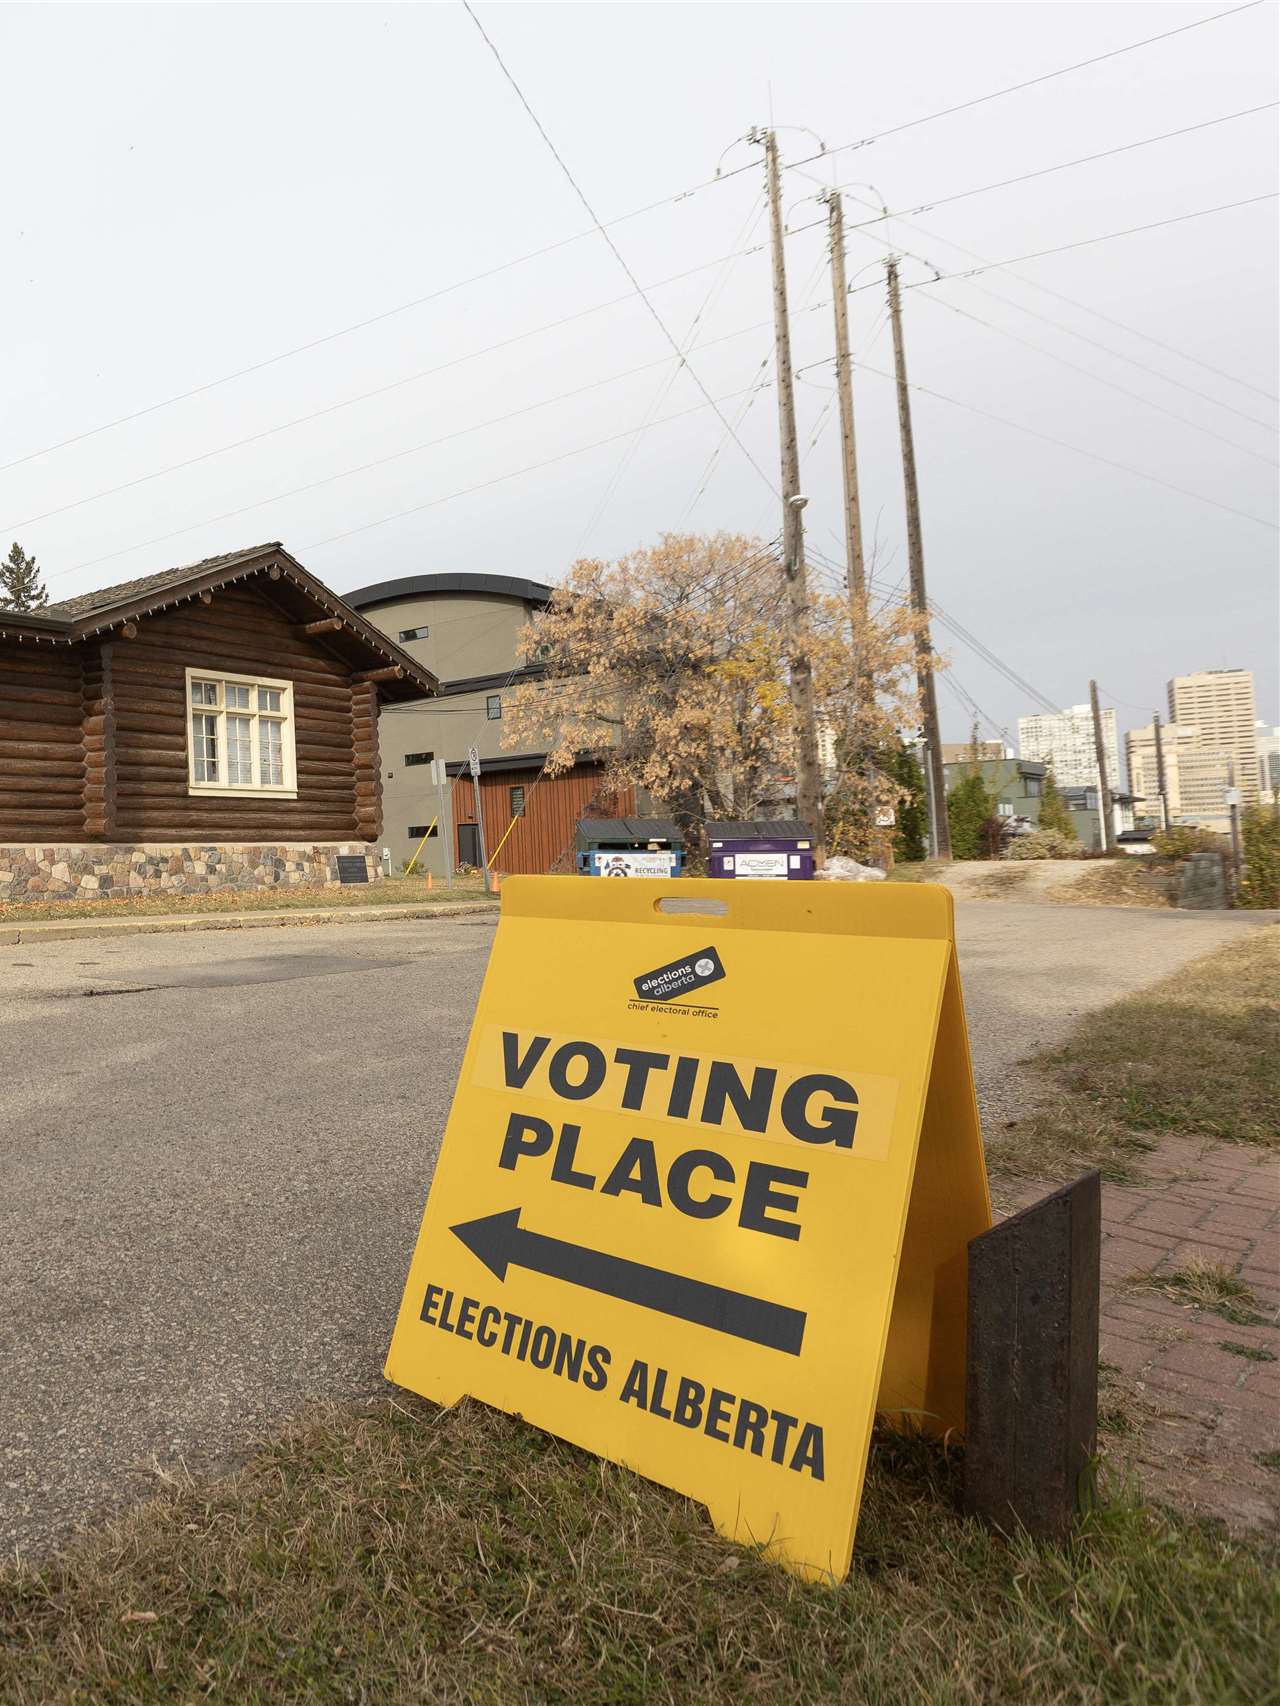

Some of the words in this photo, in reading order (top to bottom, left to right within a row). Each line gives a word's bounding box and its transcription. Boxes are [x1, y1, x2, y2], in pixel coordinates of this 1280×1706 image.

[627, 1003, 649, 1011] chief
[650, 1006, 690, 1016] electoral
[691, 1010, 719, 1019] office
[641, 965, 692, 991] elections
[653, 974, 695, 996] alberta
[502, 1031, 859, 1150] VOTING
[498, 1111, 810, 1242] PLACE
[419, 1283, 612, 1392] ELECTIONS
[618, 1359, 825, 1483] ALBERTA
